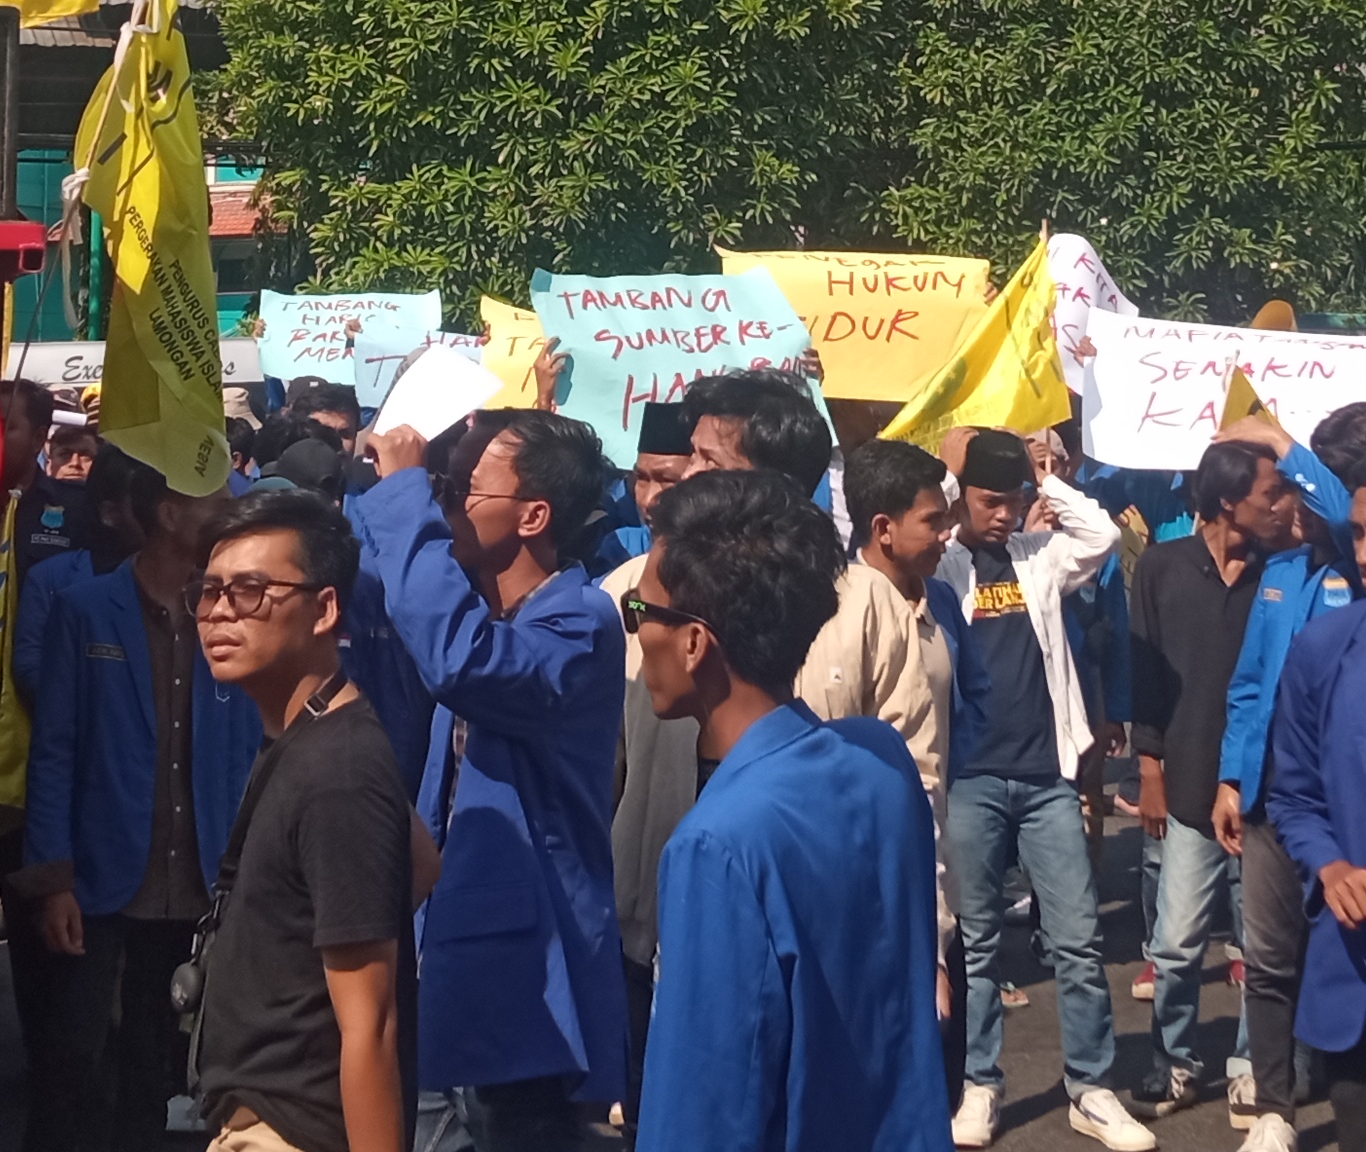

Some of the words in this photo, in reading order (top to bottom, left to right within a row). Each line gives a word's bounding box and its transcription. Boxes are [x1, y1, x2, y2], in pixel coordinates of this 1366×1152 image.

[126, 205, 166, 288] PERGERAKAN
[160, 283, 206, 363] MAHASISWA
[169, 258, 209, 328] PENGURUS
[826, 270, 966, 299] HUKUM
[281, 299, 401, 313] TAMBANG
[557, 286, 732, 320] TAMBANG
[149, 306, 195, 381] LAMONGAN
[288, 328, 345, 348] RAK
[594, 323, 731, 360] SUMBER
[1123, 325, 1244, 340] MAFIA
